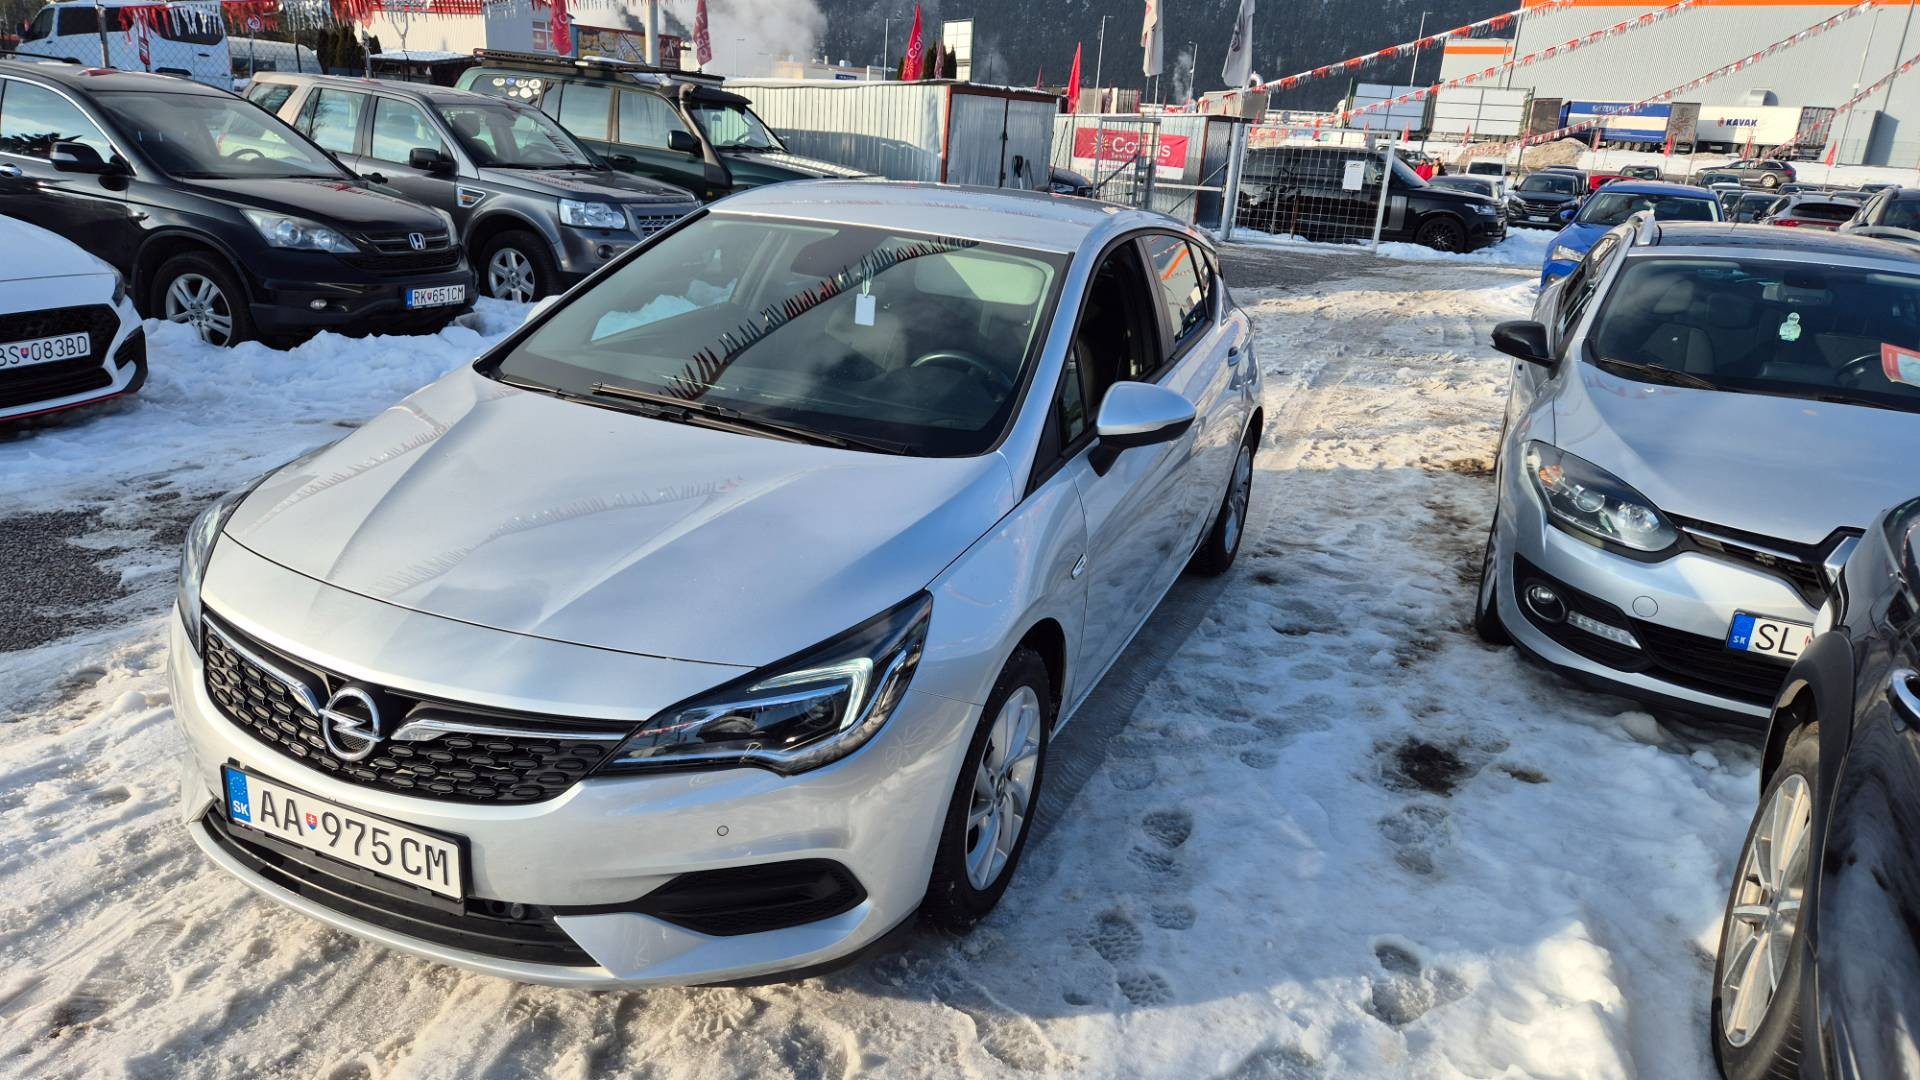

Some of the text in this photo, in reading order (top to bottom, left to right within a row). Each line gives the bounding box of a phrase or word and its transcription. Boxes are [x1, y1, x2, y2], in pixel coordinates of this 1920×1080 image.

[1725, 118, 1758, 127] KAVAK
[414, 286, 464, 305] RK 651CM
[30, 335, 88, 361] 083BD
[1732, 635, 1747, 645] SK
[1755, 623, 1798, 656] SL
[232, 800, 249, 816] SK
[260, 789, 449, 886] AA 975CM
